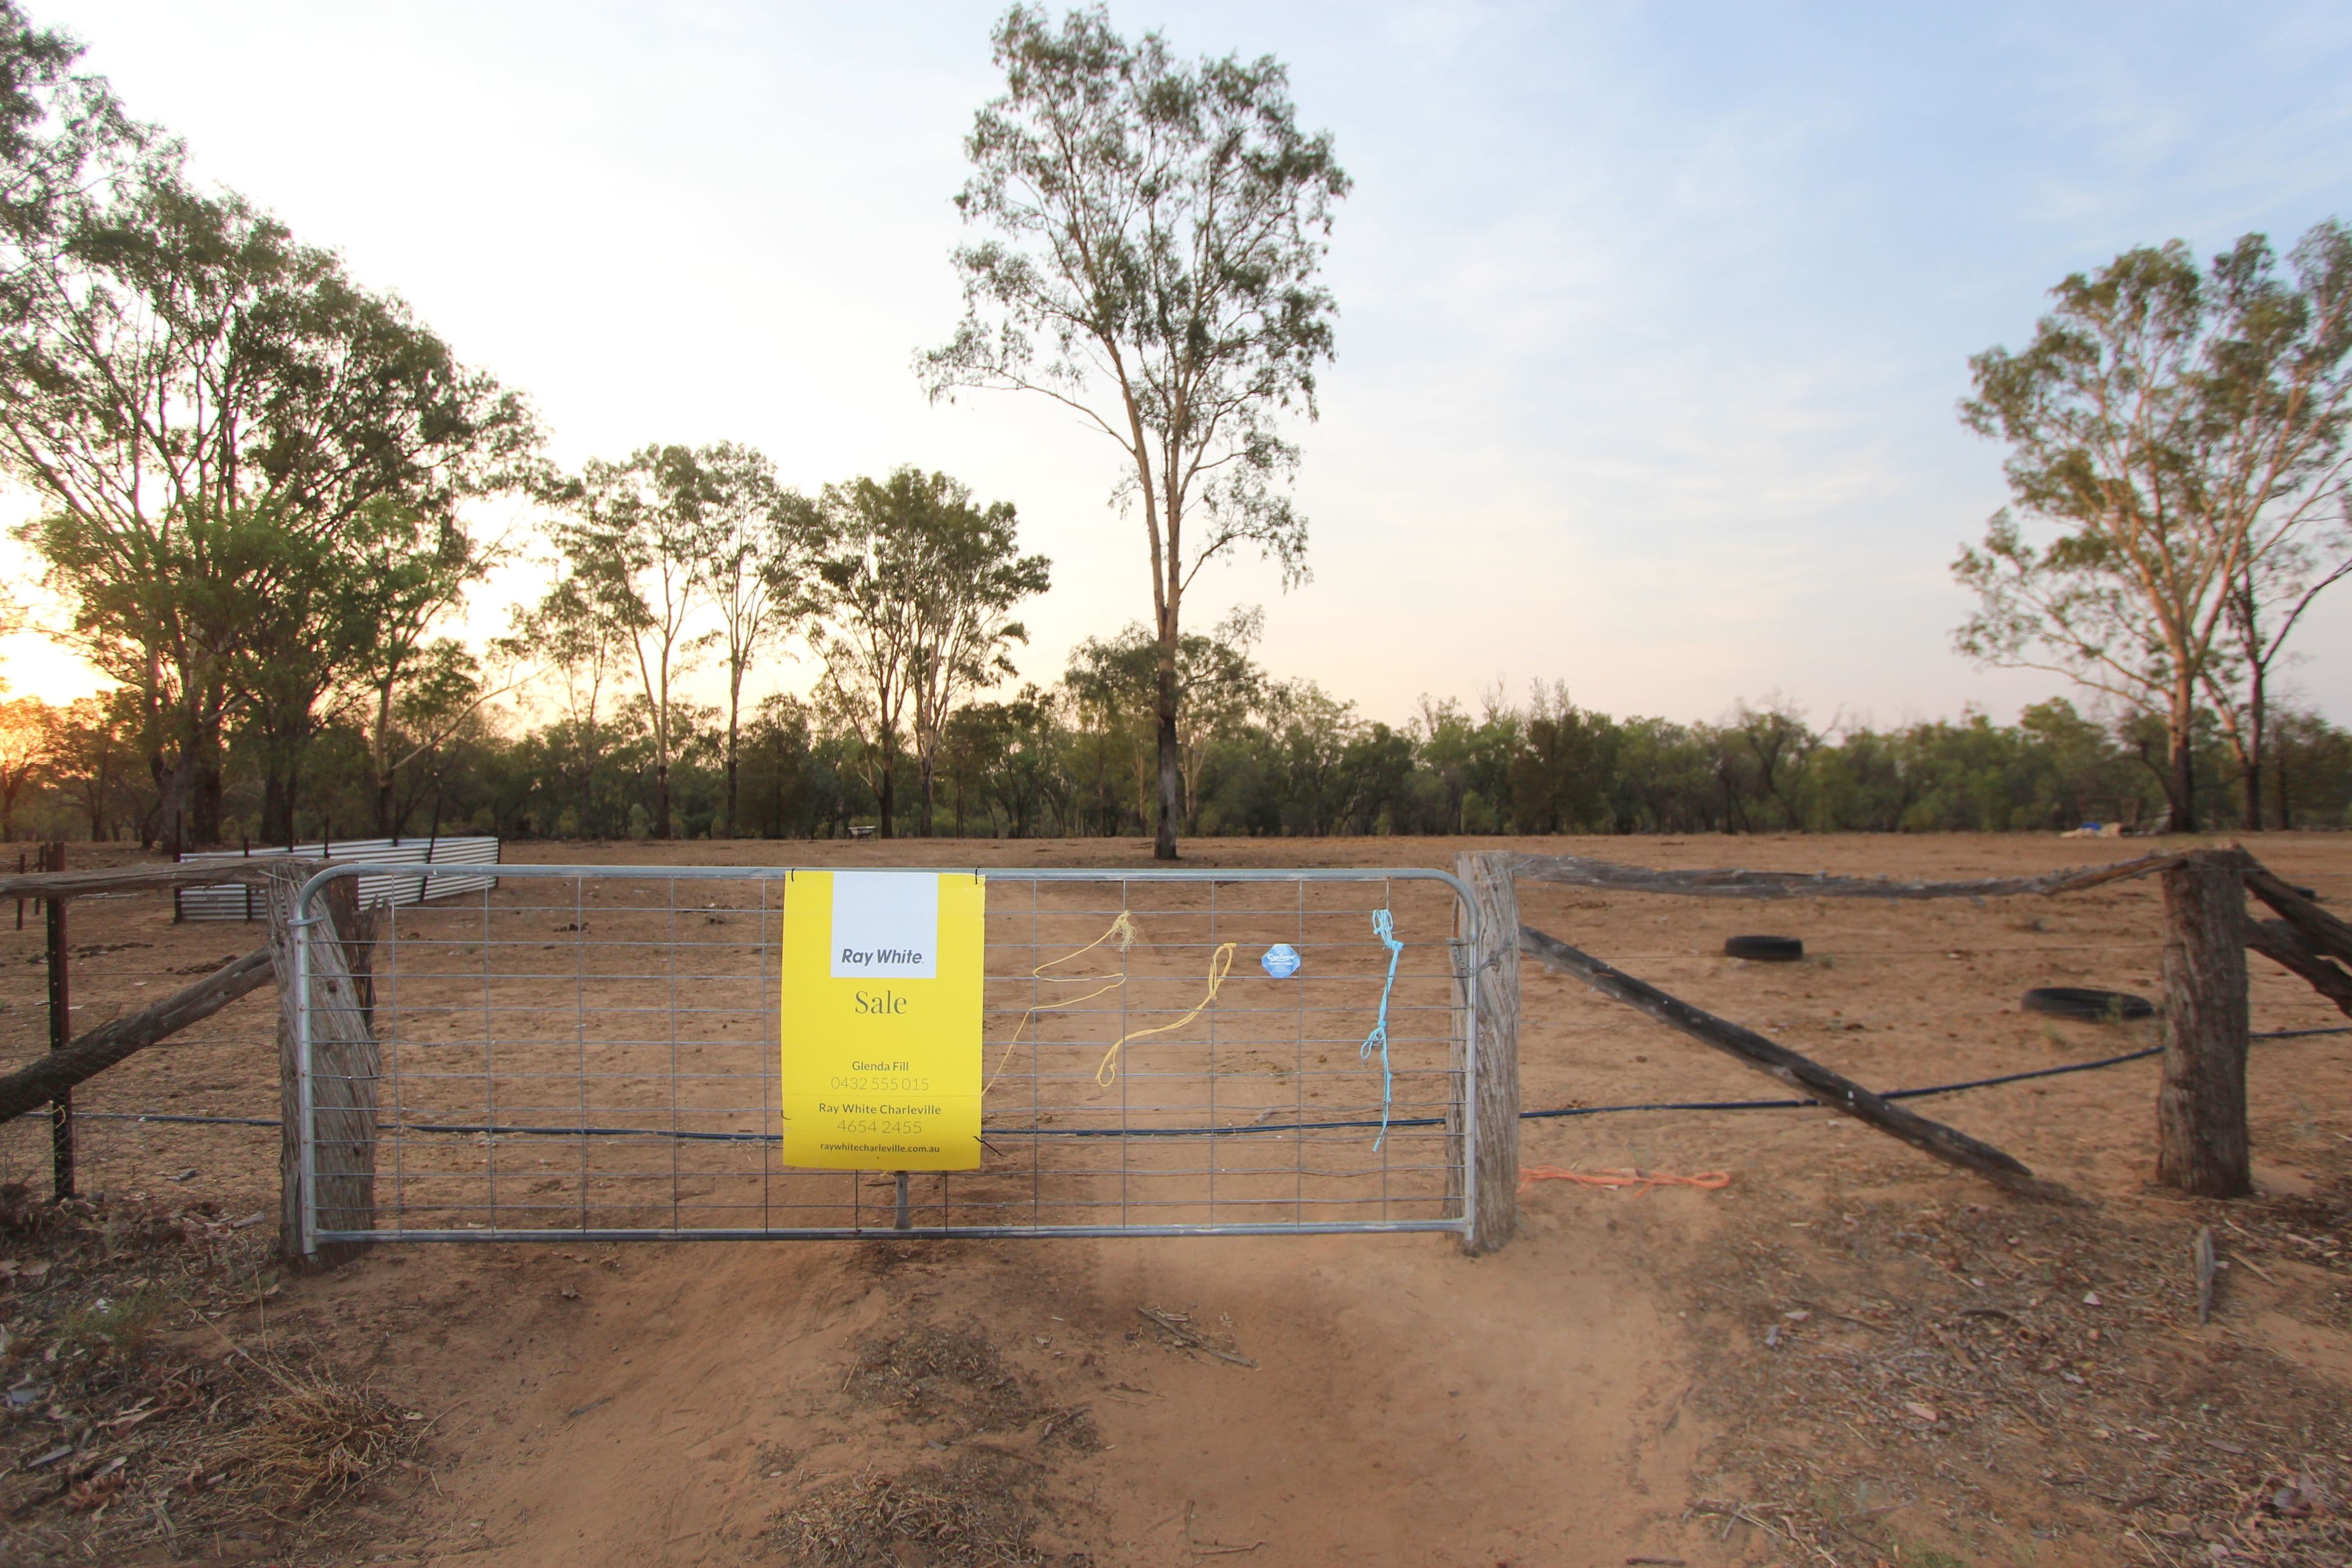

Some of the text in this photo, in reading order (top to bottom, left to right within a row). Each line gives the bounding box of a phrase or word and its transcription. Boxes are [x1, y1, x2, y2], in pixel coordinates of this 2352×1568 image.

[842, 948, 922, 966] Ray White
[855, 990, 907, 1014] Sale
[852, 1061, 909, 1071] Glenda Fill
[831, 1077, 929, 1091] 0432 555 015
[819, 1103, 941, 1115] Ray White Charleville
[837, 1120, 922, 1134] 4654 2455
[820, 1143, 940, 1153] raywhitecharleville.com.au
